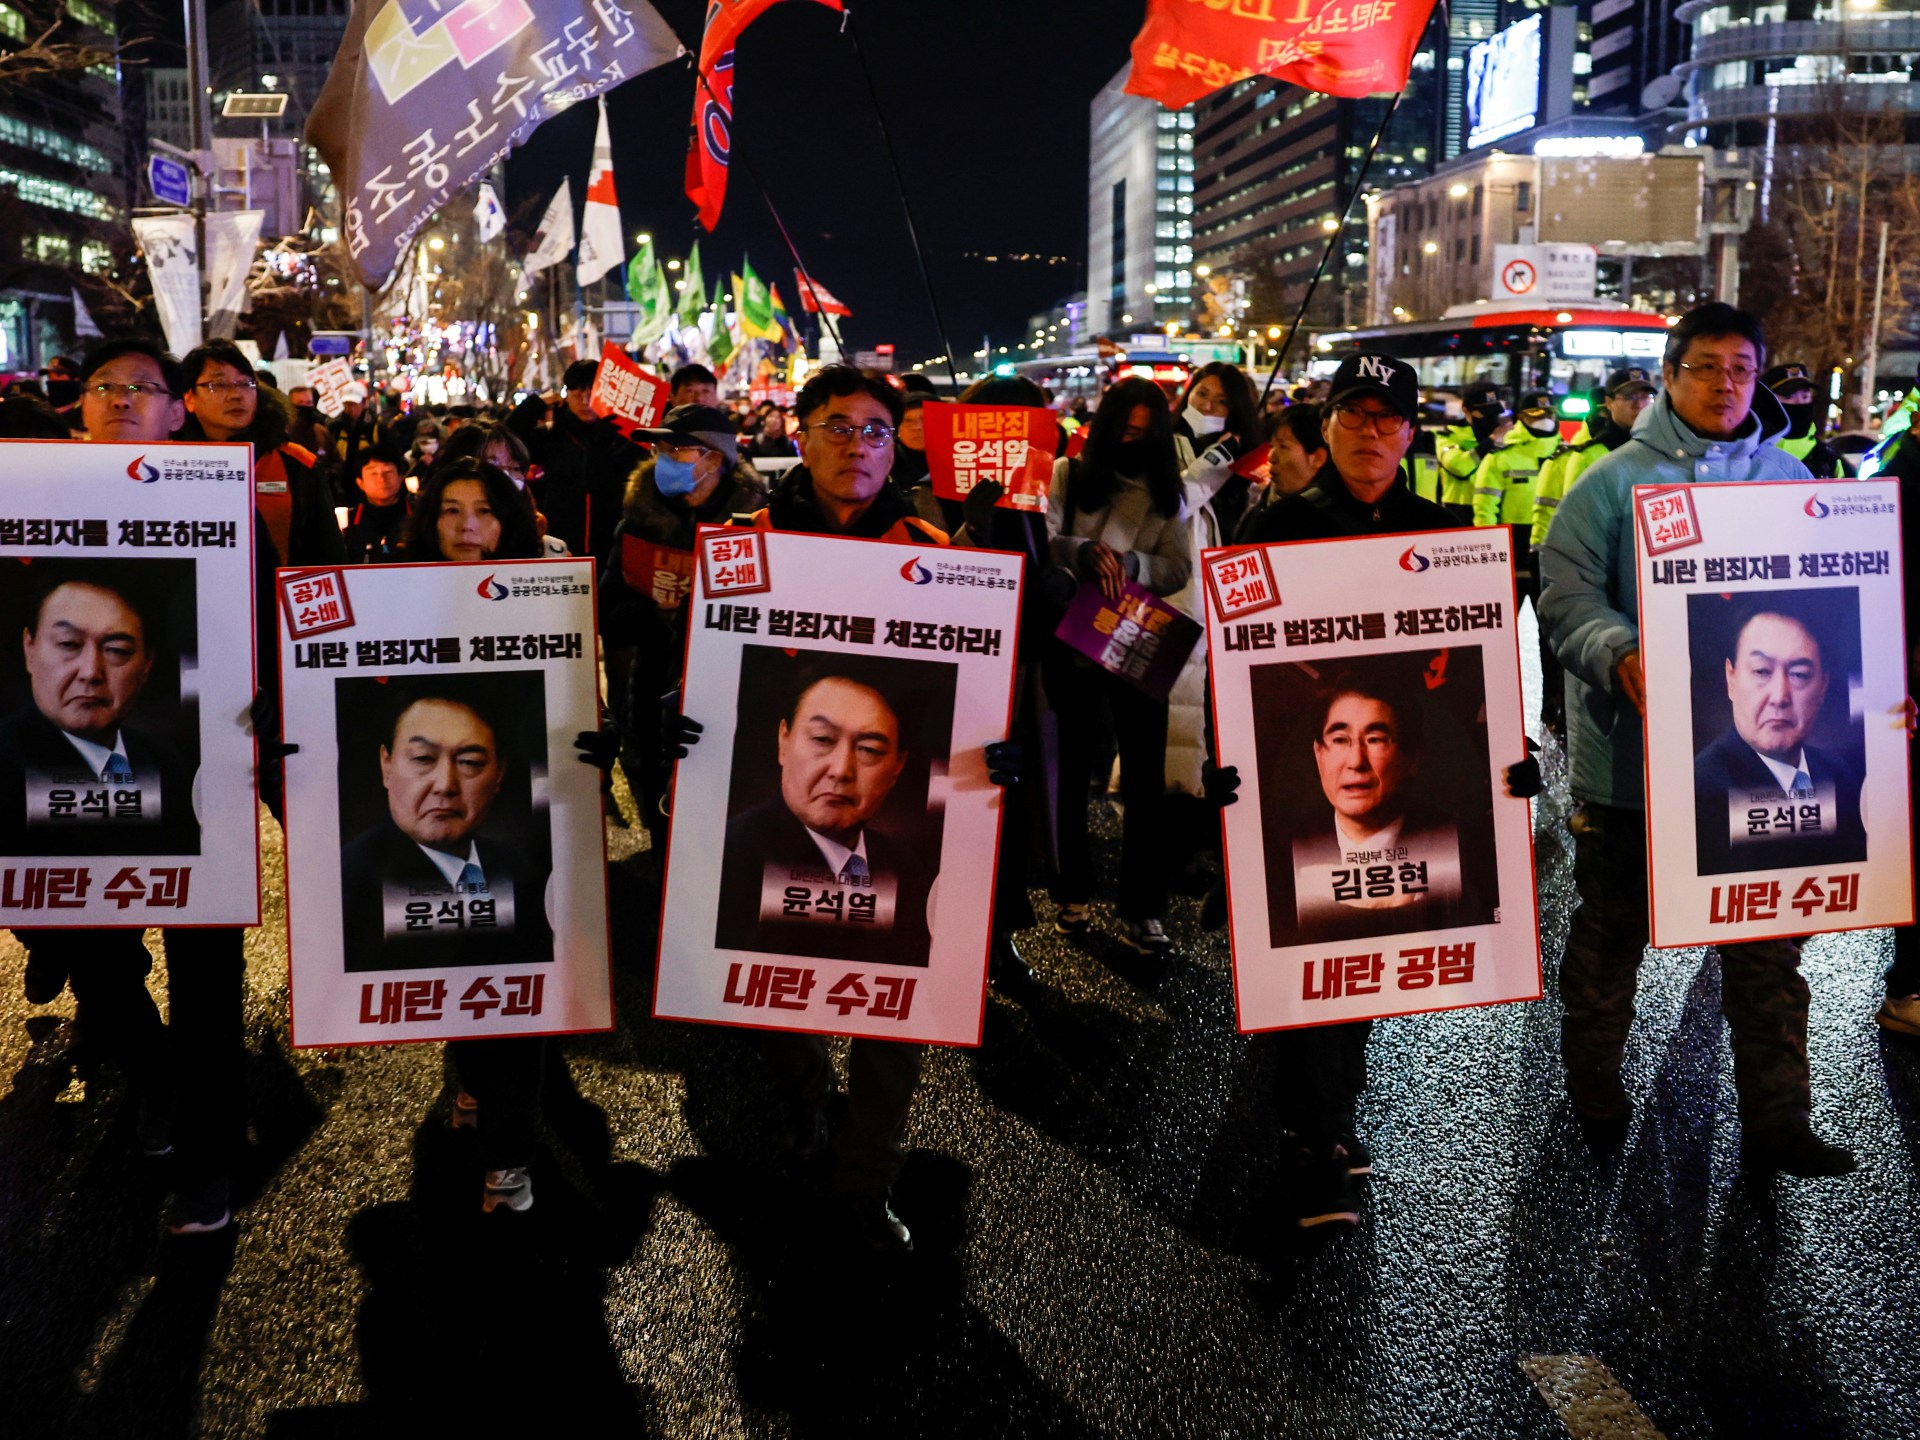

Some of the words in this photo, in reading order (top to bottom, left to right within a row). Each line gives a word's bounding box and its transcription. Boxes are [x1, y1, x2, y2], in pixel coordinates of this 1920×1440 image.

[599, 358, 656, 405] 윤석열을
[1356, 355, 1396, 387] NY
[952, 411, 1029, 439] 내란죄
[952, 440, 1029, 468] 윤석열
[164, 469, 246, 481] 공공연대노동조합
[1648, 495, 1684, 521] 공개
[118, 520, 236, 548] 체포하라!
[1654, 518, 1691, 544] 수배
[711, 537, 754, 563] 공개
[1432, 551, 1507, 568] 공공연대노동조합
[714, 562, 756, 587] 수배
[936, 572, 1017, 590] 공공연대노동조합
[1217, 555, 1259, 585] 공개
[1652, 558, 1697, 585] 내란
[1704, 555, 1791, 582] 범죄자를
[1798, 551, 1889, 579] 체포하라!
[293, 577, 335, 604] 공개
[511, 584, 590, 597] 공공연대노동조합
[1225, 579, 1267, 608] 수배
[299, 600, 341, 627] 수배
[1223, 621, 1276, 651] 내란
[1283, 612, 1386, 646] 범죄자를
[1394, 602, 1503, 636] 체포하라!
[704, 603, 762, 634] 내란
[767, 609, 875, 645] 범죄자를
[883, 618, 1002, 656] 체포하라!
[295, 642, 348, 669] 내란
[356, 637, 461, 667] 범죄자를
[469, 633, 583, 662] 체포하라!
[48, 789, 142, 818] 윤석열
[1747, 803, 1821, 836] 윤석열
[1345, 850, 1382, 865] 국방부
[1384, 846, 1409, 861] 장관
[2, 867, 92, 910] 내란
[104, 866, 192, 910] 수괴
[1331, 861, 1429, 901] 김용현
[783, 886, 877, 923] 윤석열
[1709, 880, 1782, 924] 내란
[1791, 873, 1860, 918] 수괴
[405, 898, 496, 931] 윤석열
[1302, 952, 1385, 1001] 내란
[1397, 941, 1476, 991] 공범
[359, 979, 448, 1024] 내란
[459, 974, 546, 1020] 수괴
[722, 962, 817, 1011] 내란
[825, 972, 918, 1021] 수괴
